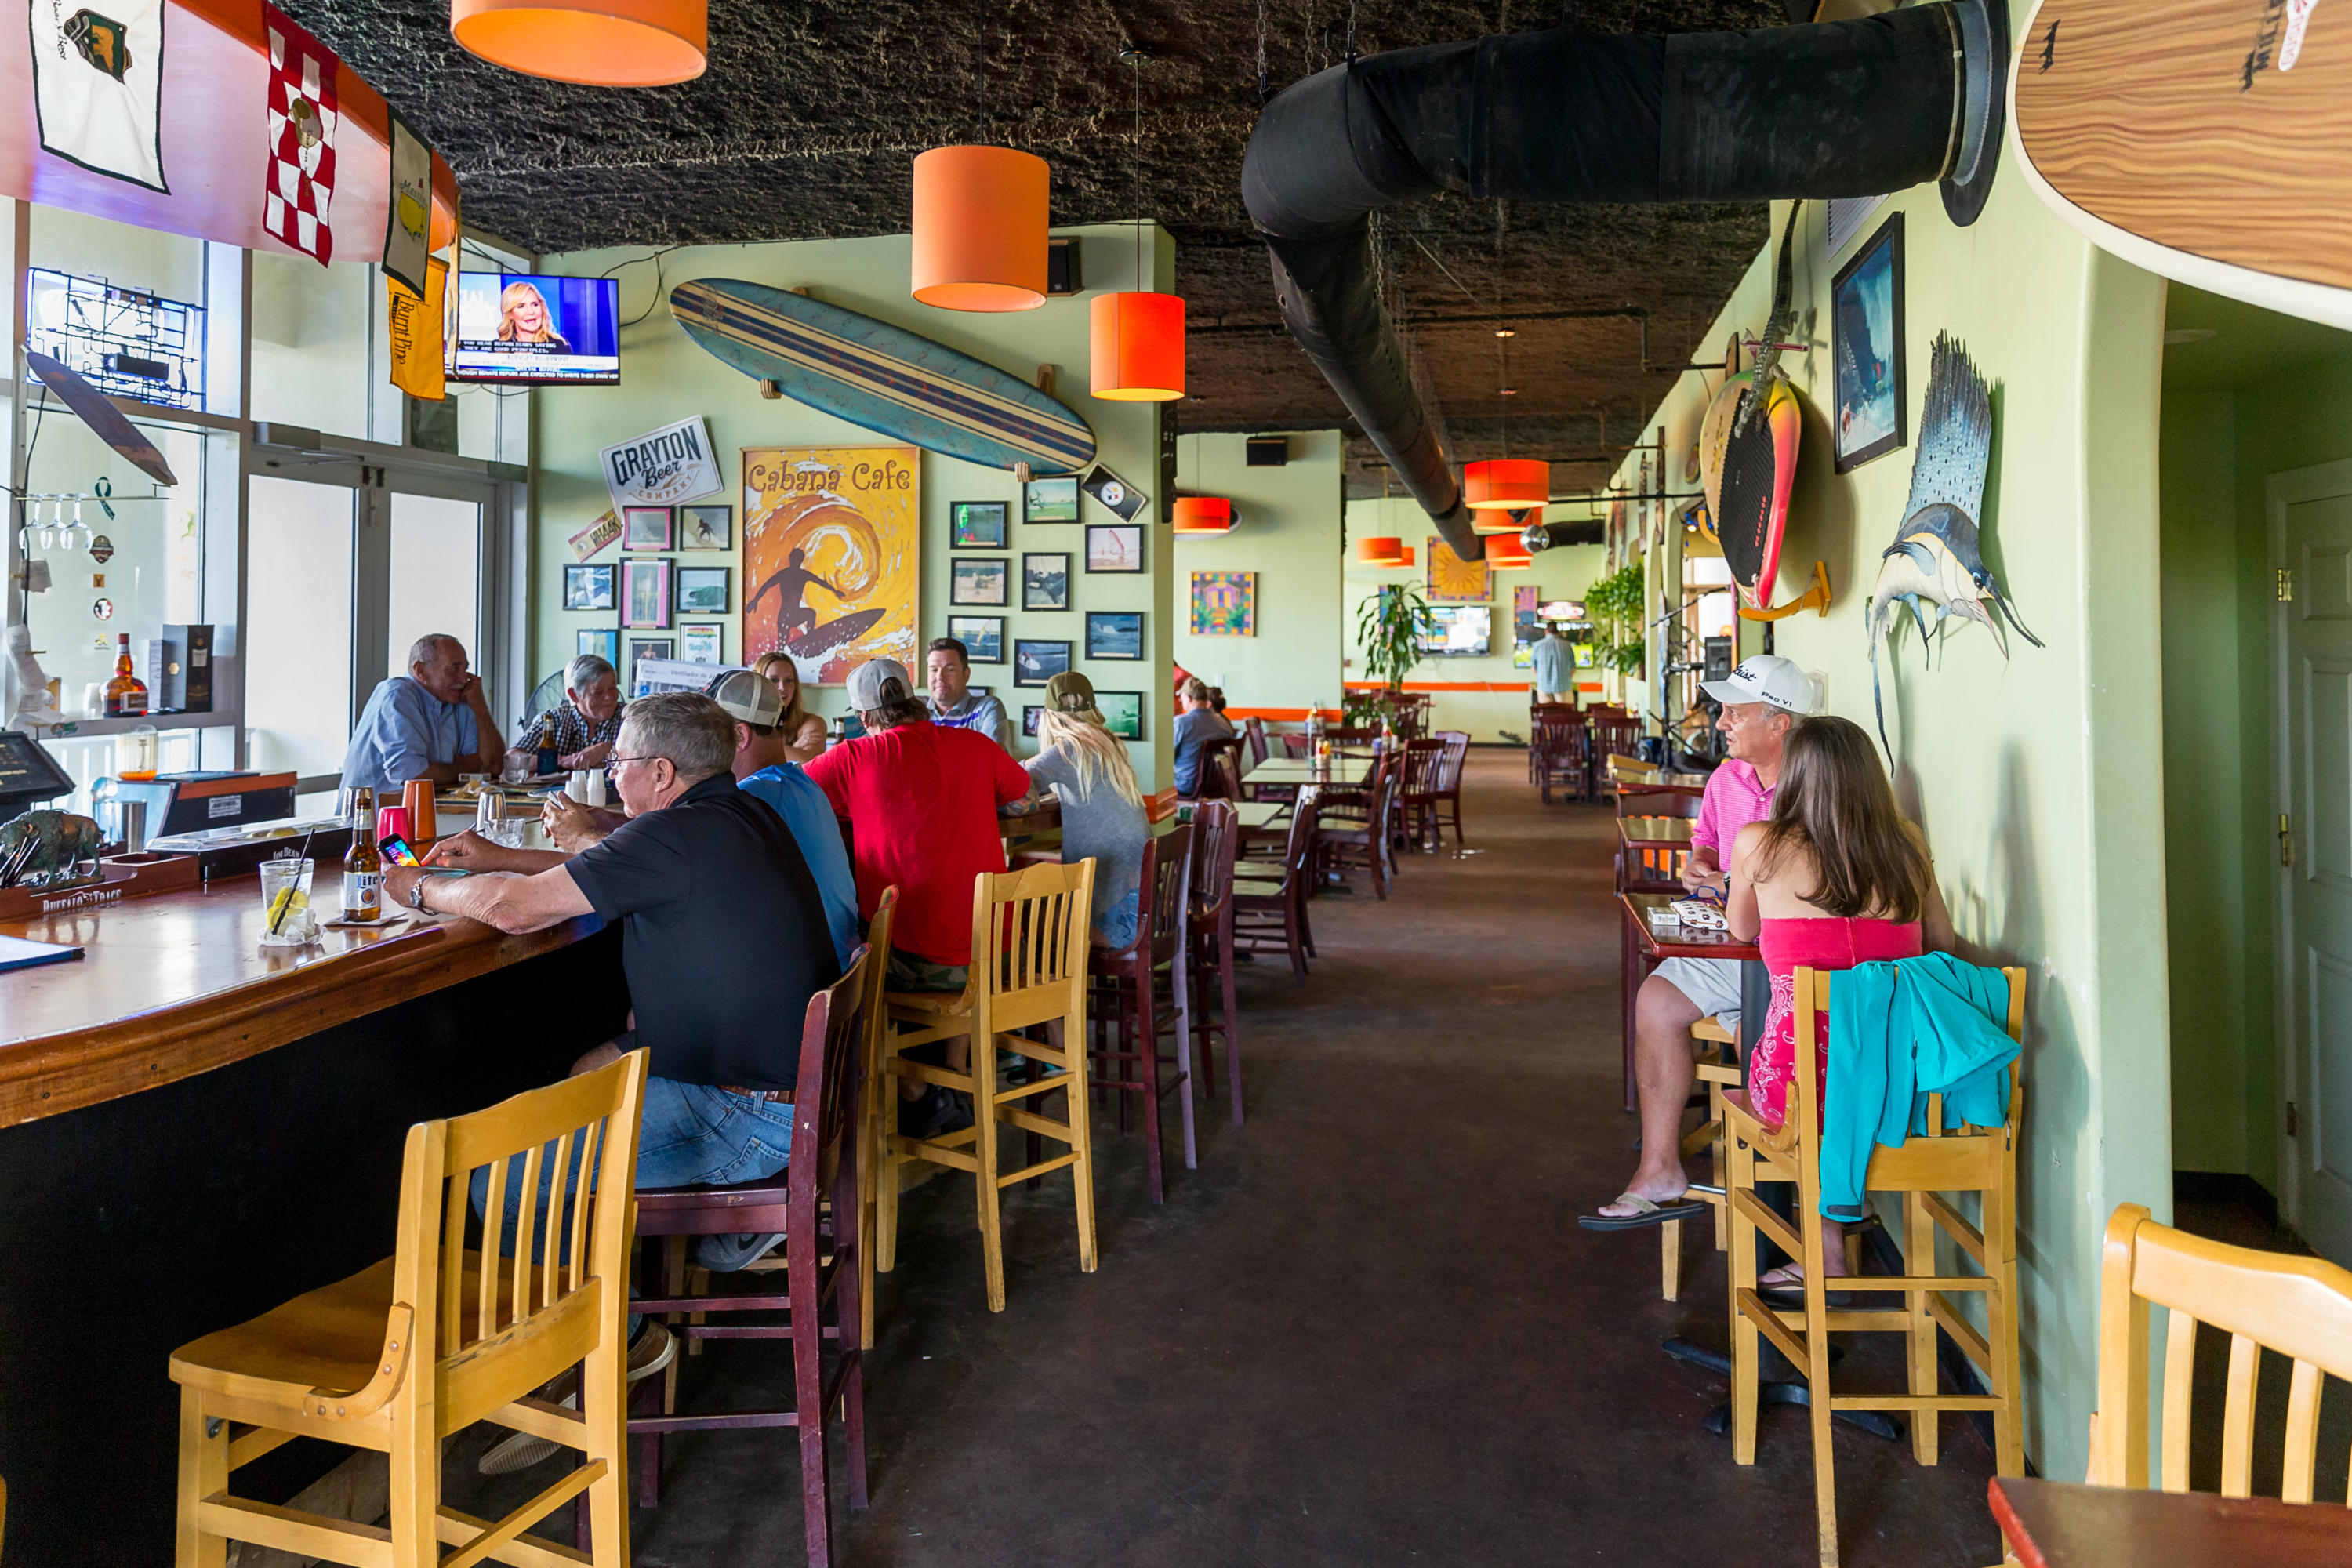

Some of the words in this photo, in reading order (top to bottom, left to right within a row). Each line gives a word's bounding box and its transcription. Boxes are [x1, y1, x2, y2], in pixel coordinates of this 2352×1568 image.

[394, 299, 415, 337] Burnt
[394, 337, 412, 365] Pine
[610, 424, 702, 487] GRAYTON
[637, 474, 693, 500] COMPANY
[641, 460, 682, 490] Beer
[748, 459, 841, 492] Cabana
[851, 459, 911, 492] Cafe
[283, 846, 301, 858] BEAM
[356, 875, 378, 889] Lite
